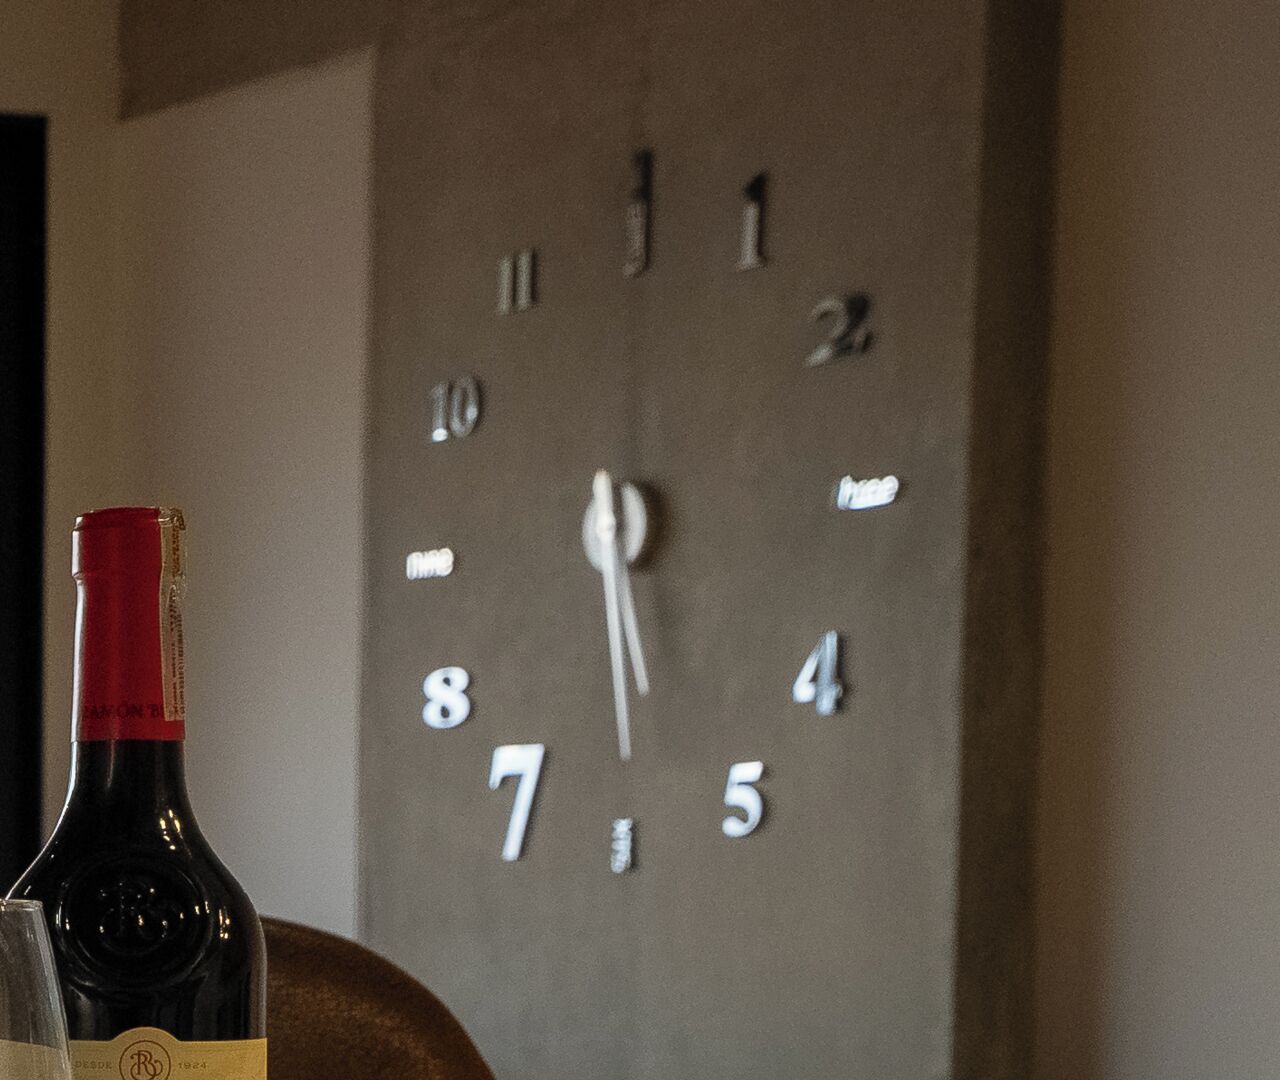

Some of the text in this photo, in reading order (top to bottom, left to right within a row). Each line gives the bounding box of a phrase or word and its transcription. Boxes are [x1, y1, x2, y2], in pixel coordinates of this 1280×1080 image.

[431, 376, 481, 442] 10
[422, 665, 472, 729] 8
[793, 631, 843, 717] 4
[490, 743, 545, 861] 7
[721, 760, 764, 837] 5
